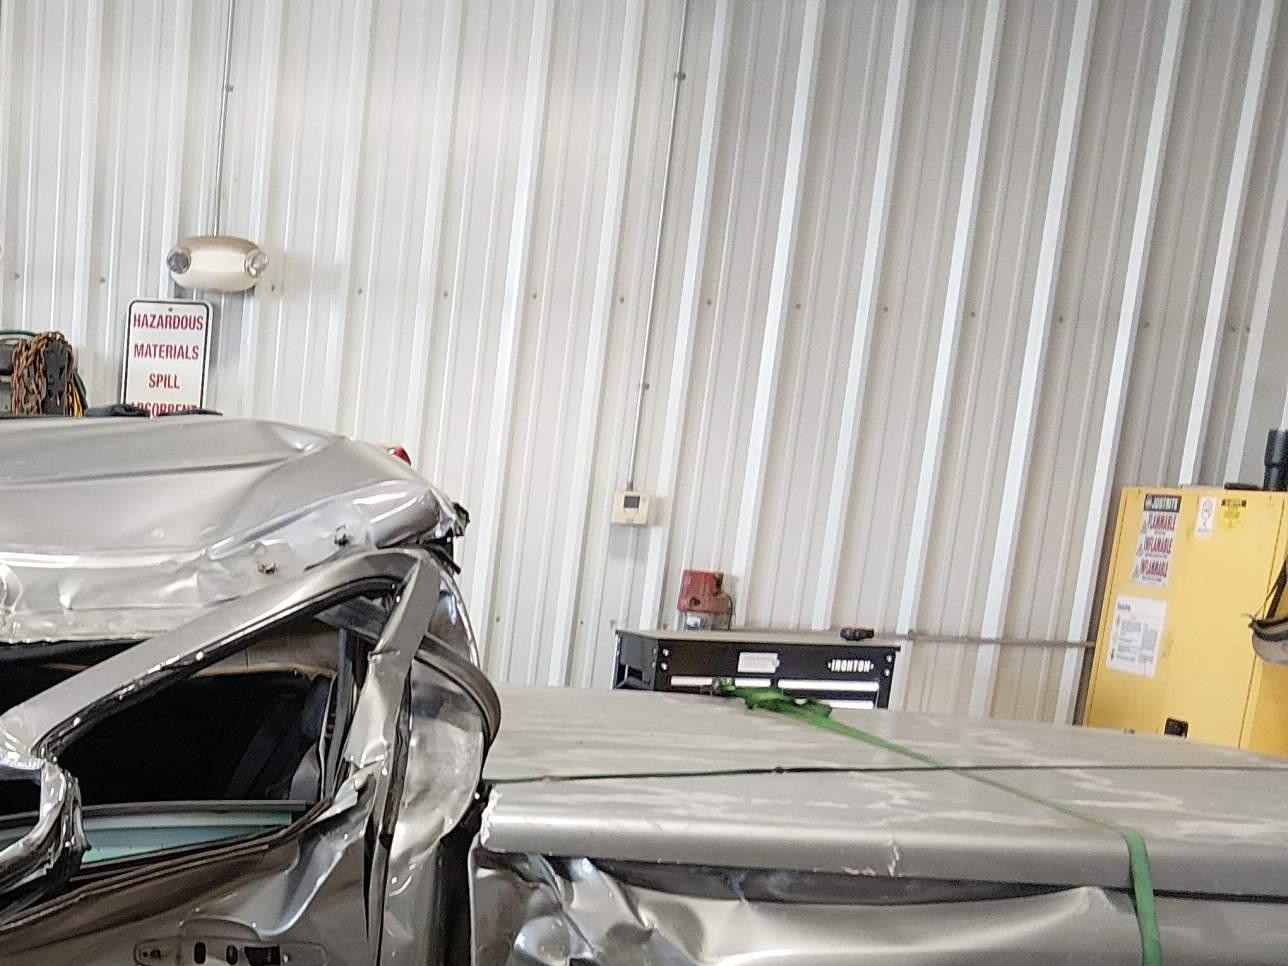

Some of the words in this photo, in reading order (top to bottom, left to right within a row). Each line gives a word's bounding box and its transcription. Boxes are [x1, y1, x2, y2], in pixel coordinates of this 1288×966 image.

[133, 313, 204, 331] HAZARDOUS
[133, 343, 199, 361] MATERIALS
[148, 373, 180, 389] SPILL
[831, 658, 871, 673] IRONTON
